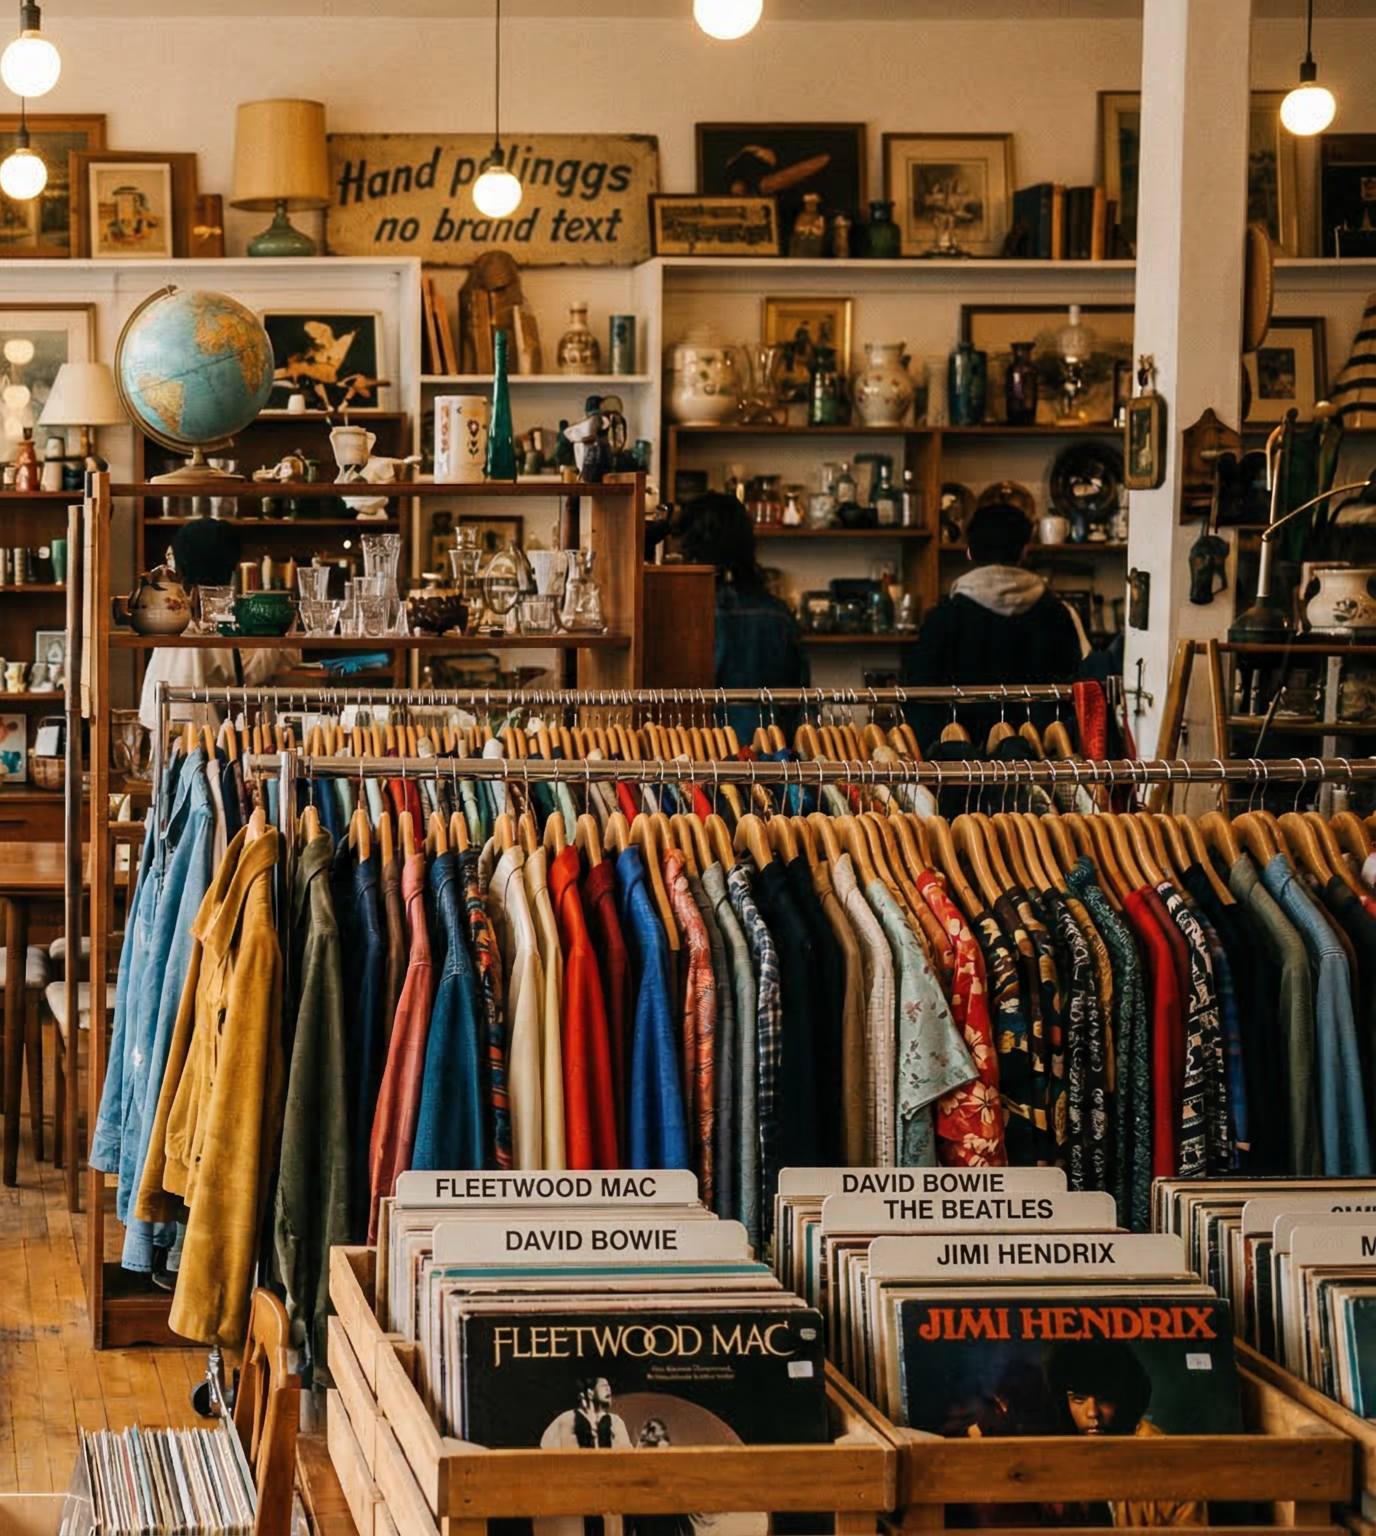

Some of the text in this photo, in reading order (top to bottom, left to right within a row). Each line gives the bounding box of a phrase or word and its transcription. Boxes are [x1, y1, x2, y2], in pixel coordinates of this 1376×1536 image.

[337, 146, 443, 205] Hand
[374, 207, 623, 243] no brand text
[435, 1176, 657, 1198] FLEETWOOD MAC
[842, 1173, 1004, 1193] DAVID BOWIE
[884, 1198, 1054, 1219] THE BEATLES
[505, 1229, 678, 1250] DAVID BOWIE
[937, 1243, 1116, 1265] JIMI HENDRIX
[919, 1306, 1217, 1341] JIMI HENDRIX
[494, 1320, 796, 1367] FLEETWOOD MAC
